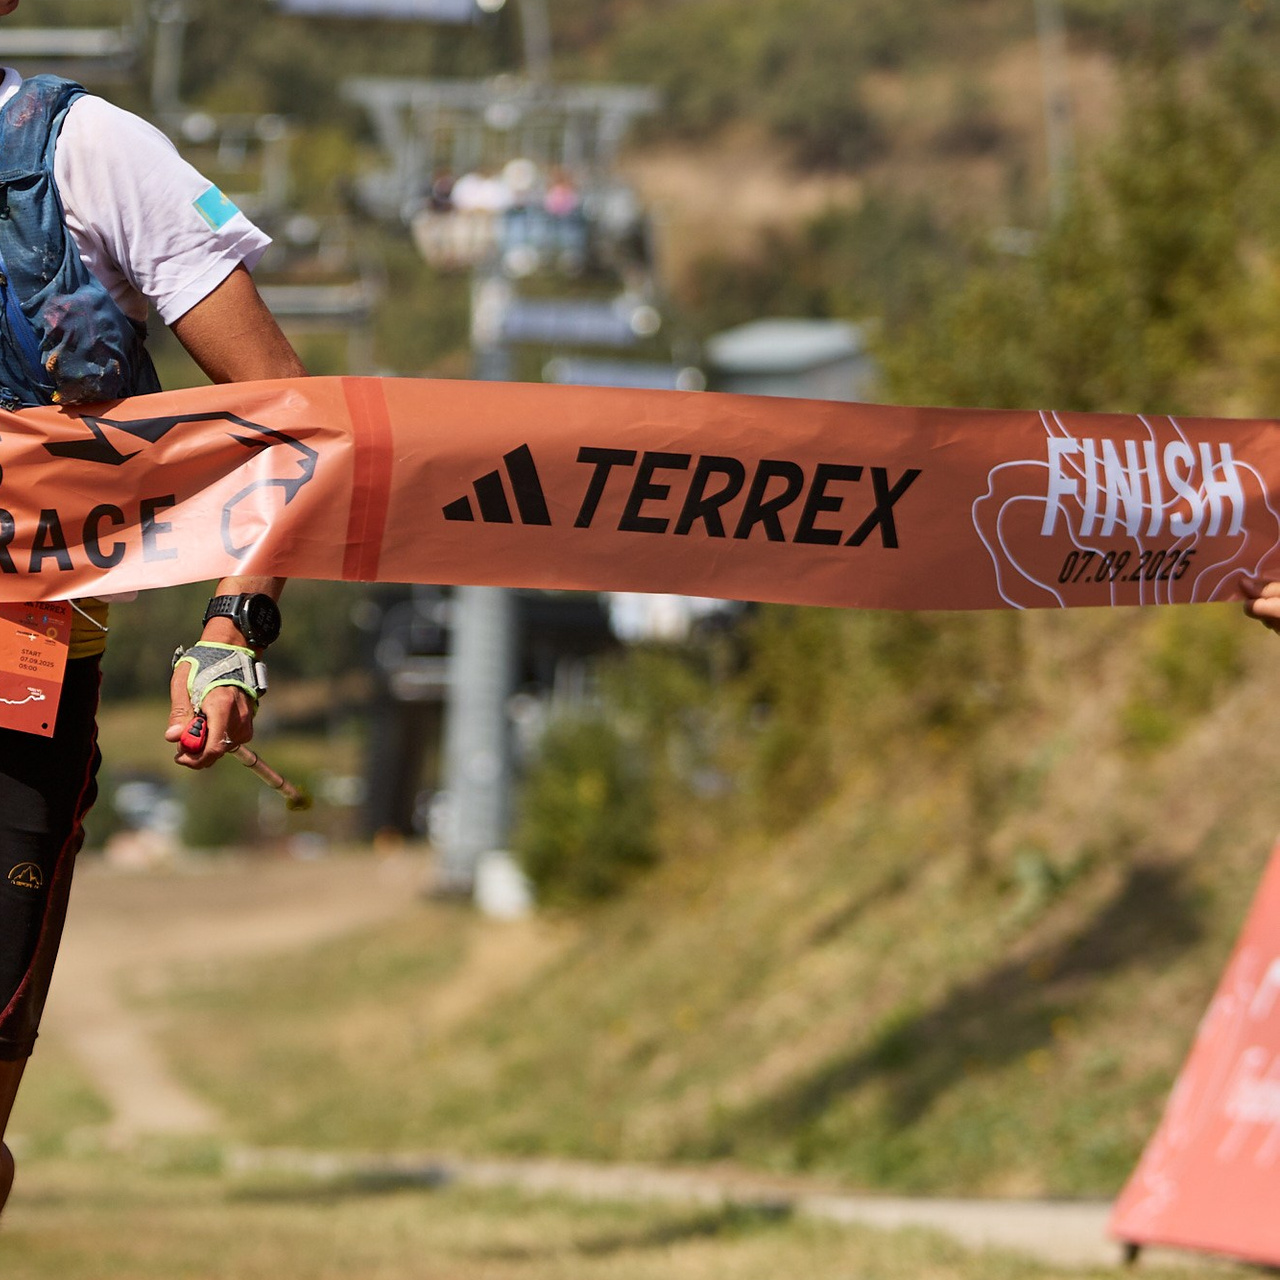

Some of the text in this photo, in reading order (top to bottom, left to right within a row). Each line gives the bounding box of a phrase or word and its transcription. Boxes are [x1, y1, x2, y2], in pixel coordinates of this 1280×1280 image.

[573, 446, 923, 549] TERREX
[1040, 437, 1245, 538] FINISH
[1057, 549, 1197, 584] 07.09.2025
[20, 656, 55, 668] 07.09.2025
[21, 648, 42, 657] START
[18, 663, 38, 672] 05:00
